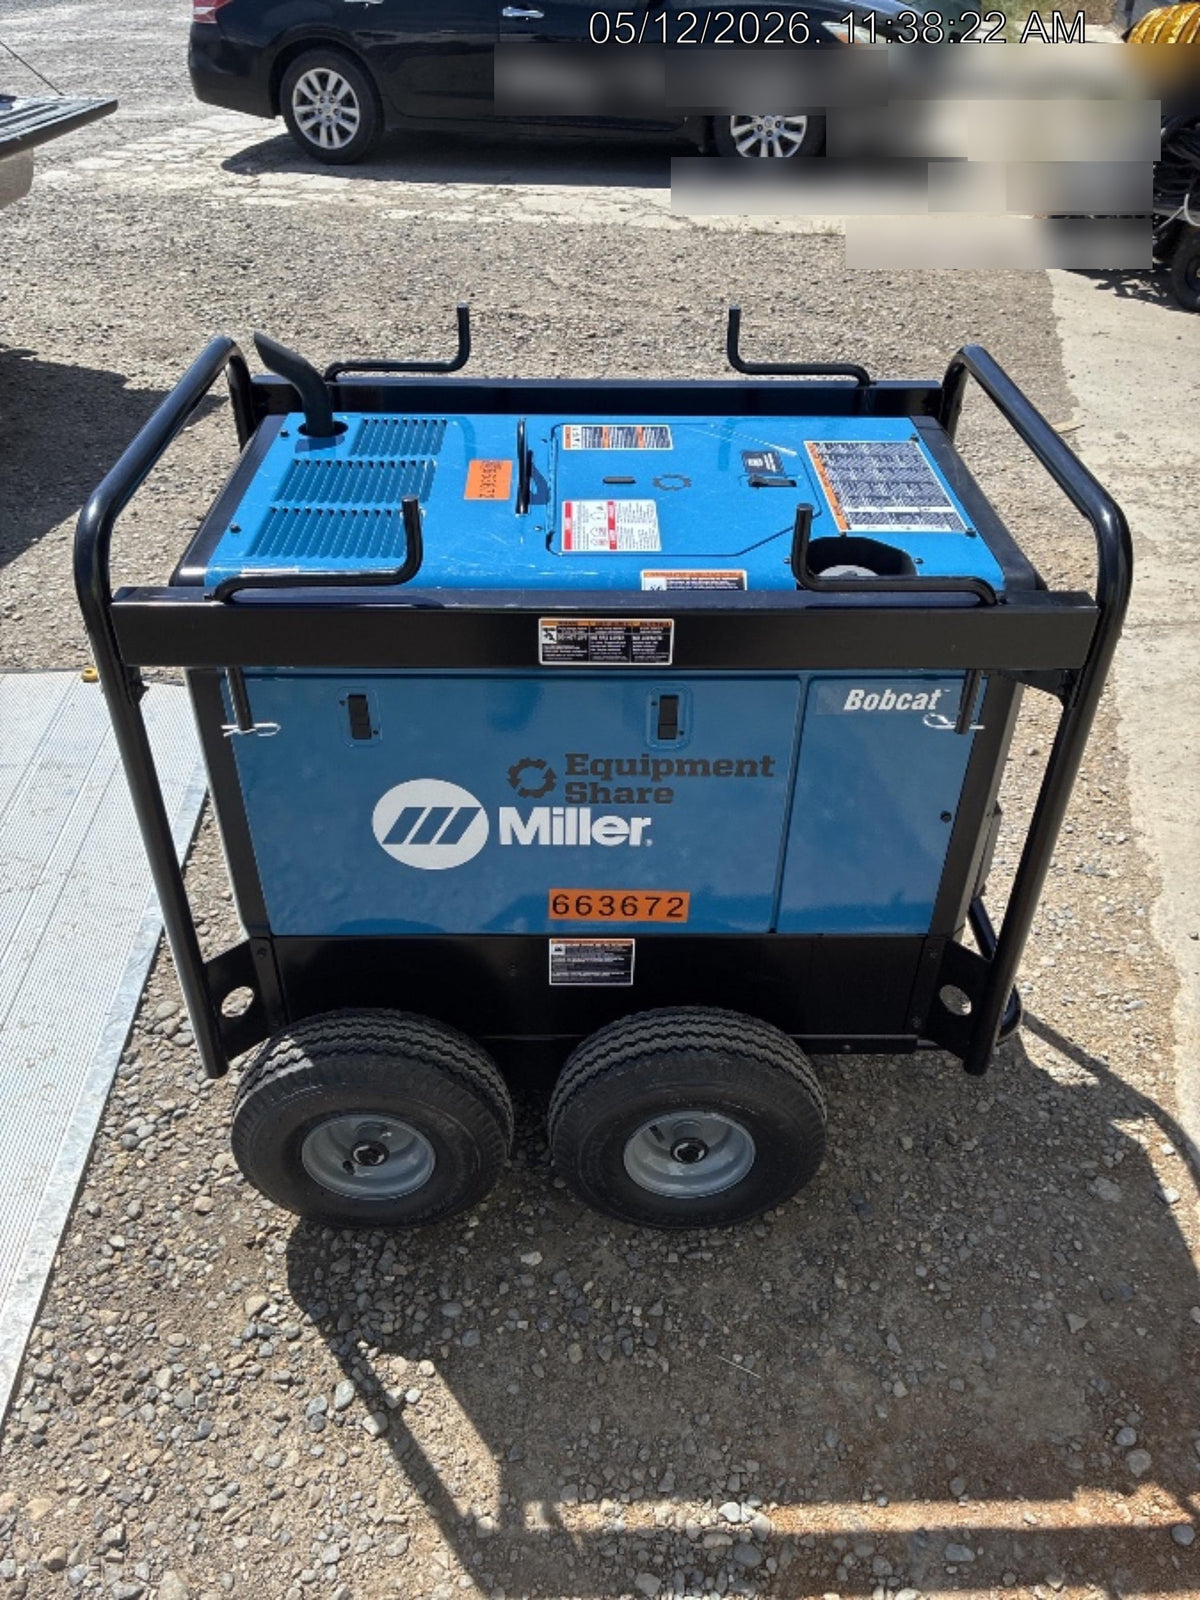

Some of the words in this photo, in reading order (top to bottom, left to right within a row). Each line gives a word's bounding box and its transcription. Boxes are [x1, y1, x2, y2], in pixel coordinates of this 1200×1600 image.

[843, 688, 942, 711] Bobcat
[564, 752, 776, 782] Equipment
[564, 781, 674, 805] Share
[552, 894, 685, 918] 663672
